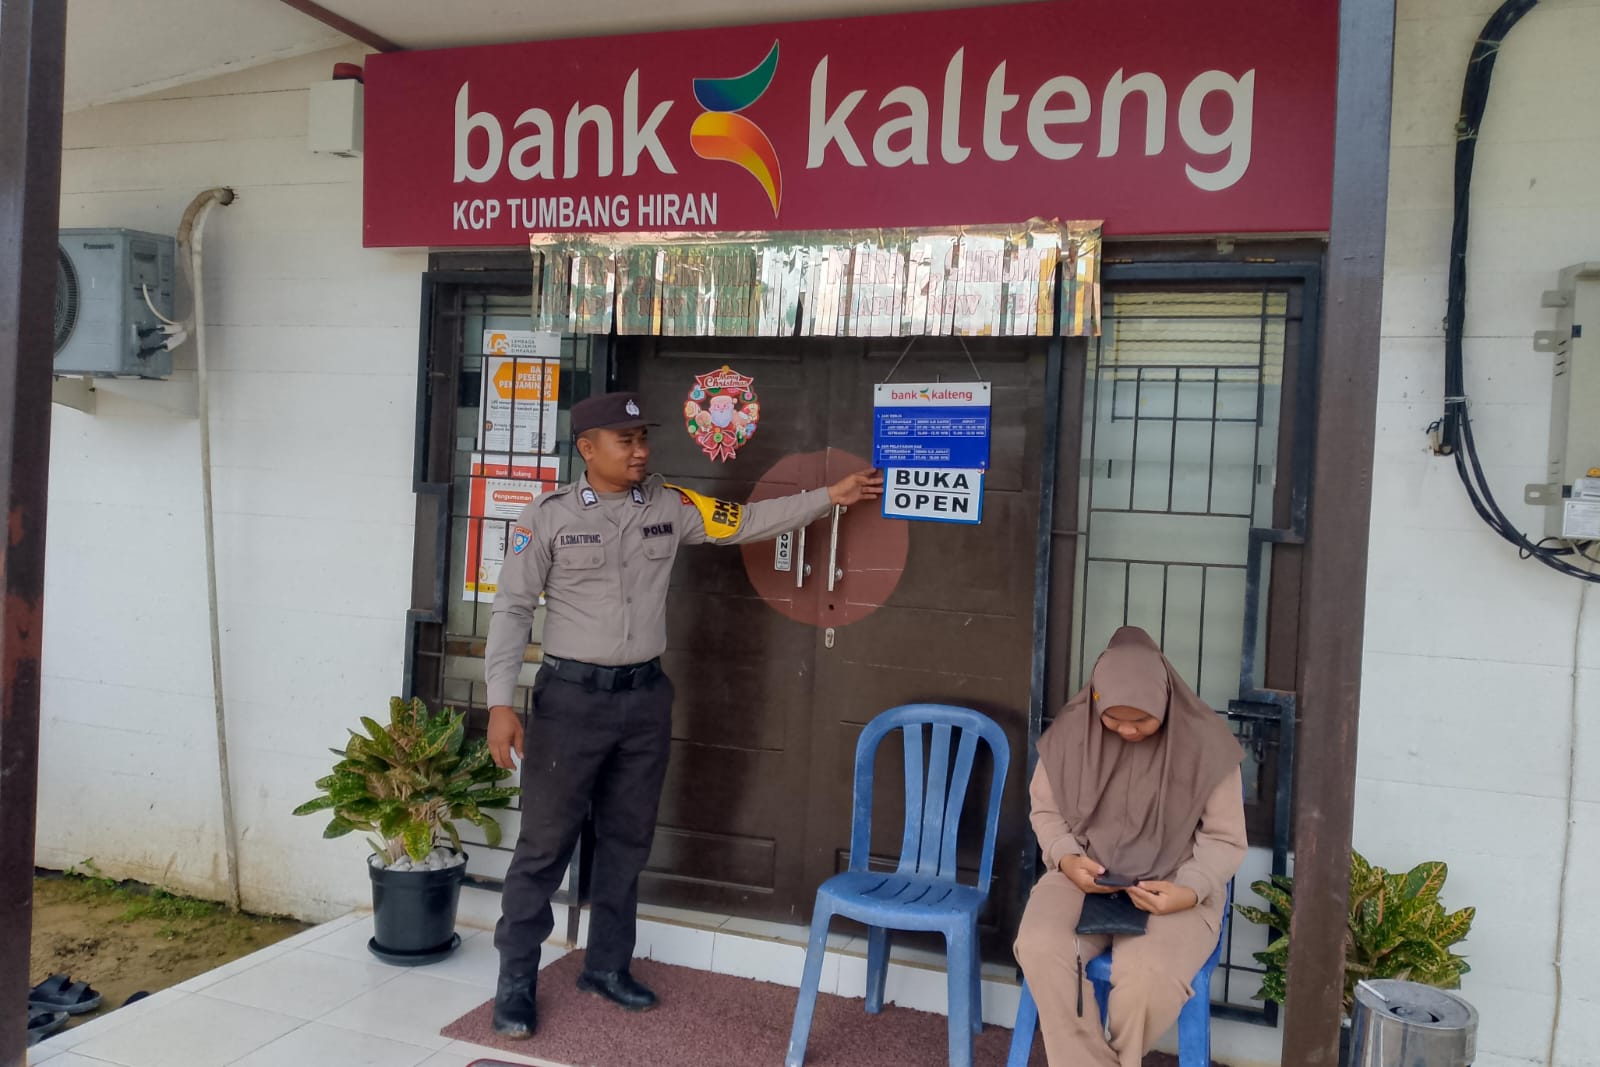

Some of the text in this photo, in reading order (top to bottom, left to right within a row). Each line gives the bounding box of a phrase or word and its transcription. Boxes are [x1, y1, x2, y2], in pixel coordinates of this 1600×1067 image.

[453, 45, 1255, 191] bank kalteng
[453, 193, 719, 230] KCP TUMBANG HIRAN
[531, 366, 553, 375] BAK
[891, 389, 973, 402] bank kalteng
[896, 470, 969, 489] BUKA
[895, 493, 969, 513] OPEN
[643, 524, 673, 537] POLRI
